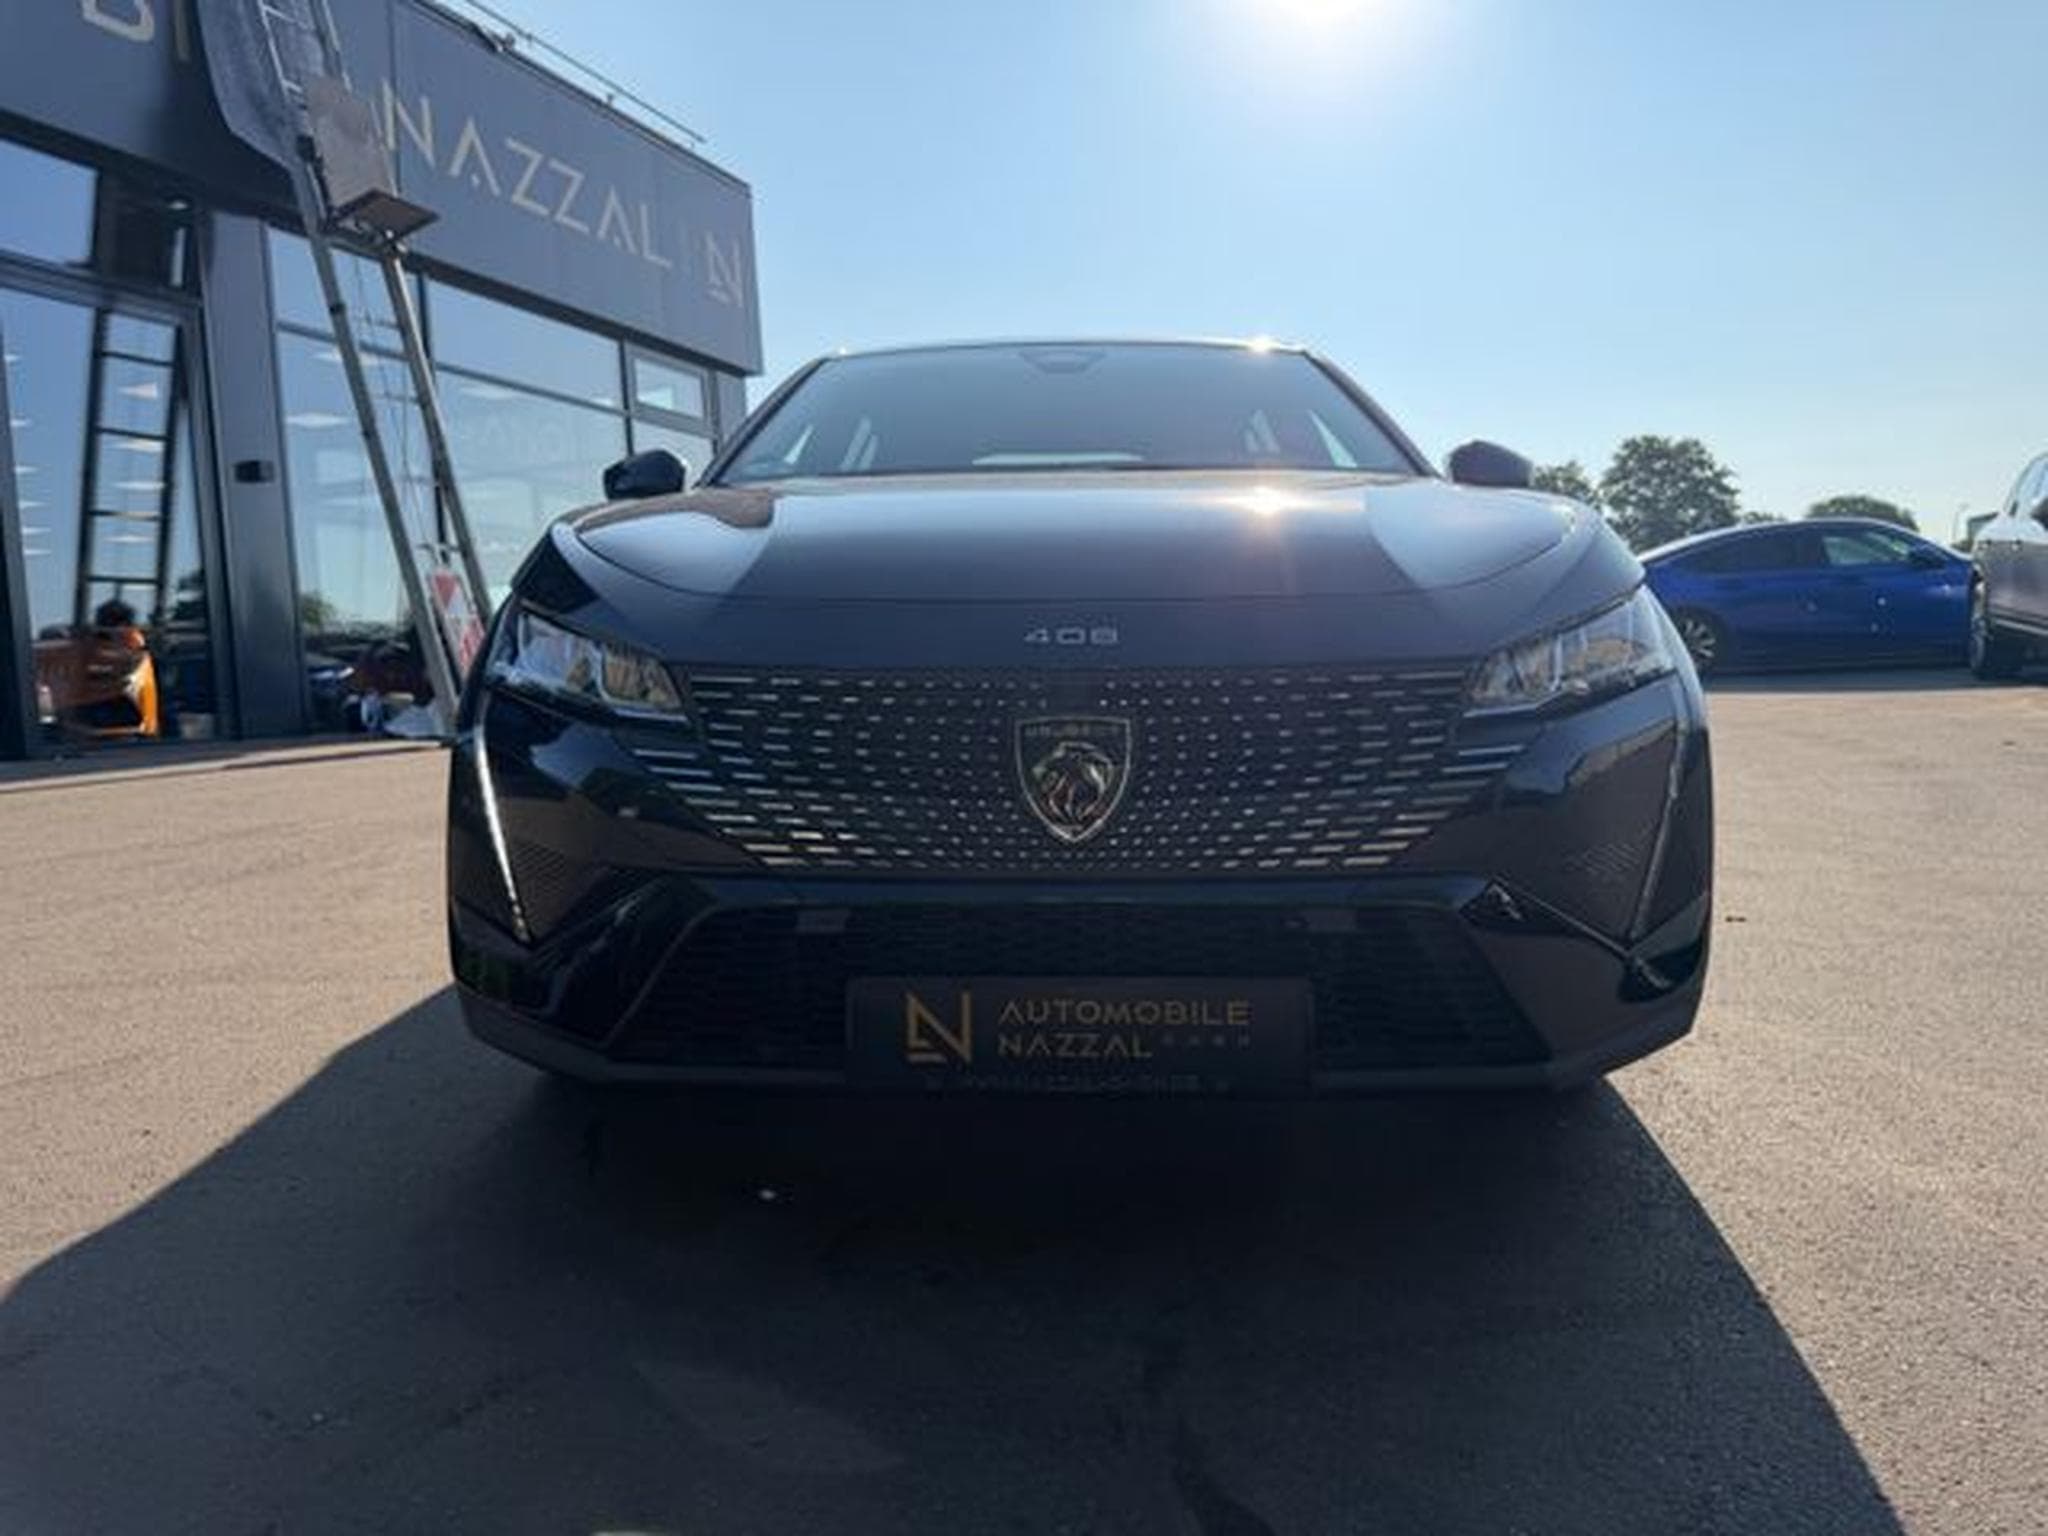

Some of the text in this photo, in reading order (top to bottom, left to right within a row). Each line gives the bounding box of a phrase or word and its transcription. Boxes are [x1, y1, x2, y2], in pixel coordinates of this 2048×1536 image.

[382, 77, 673, 269] NAZZAL
[997, 999, 1253, 1027] AUTOMOBILE
[997, 1031, 1154, 1059] NAZZAL
